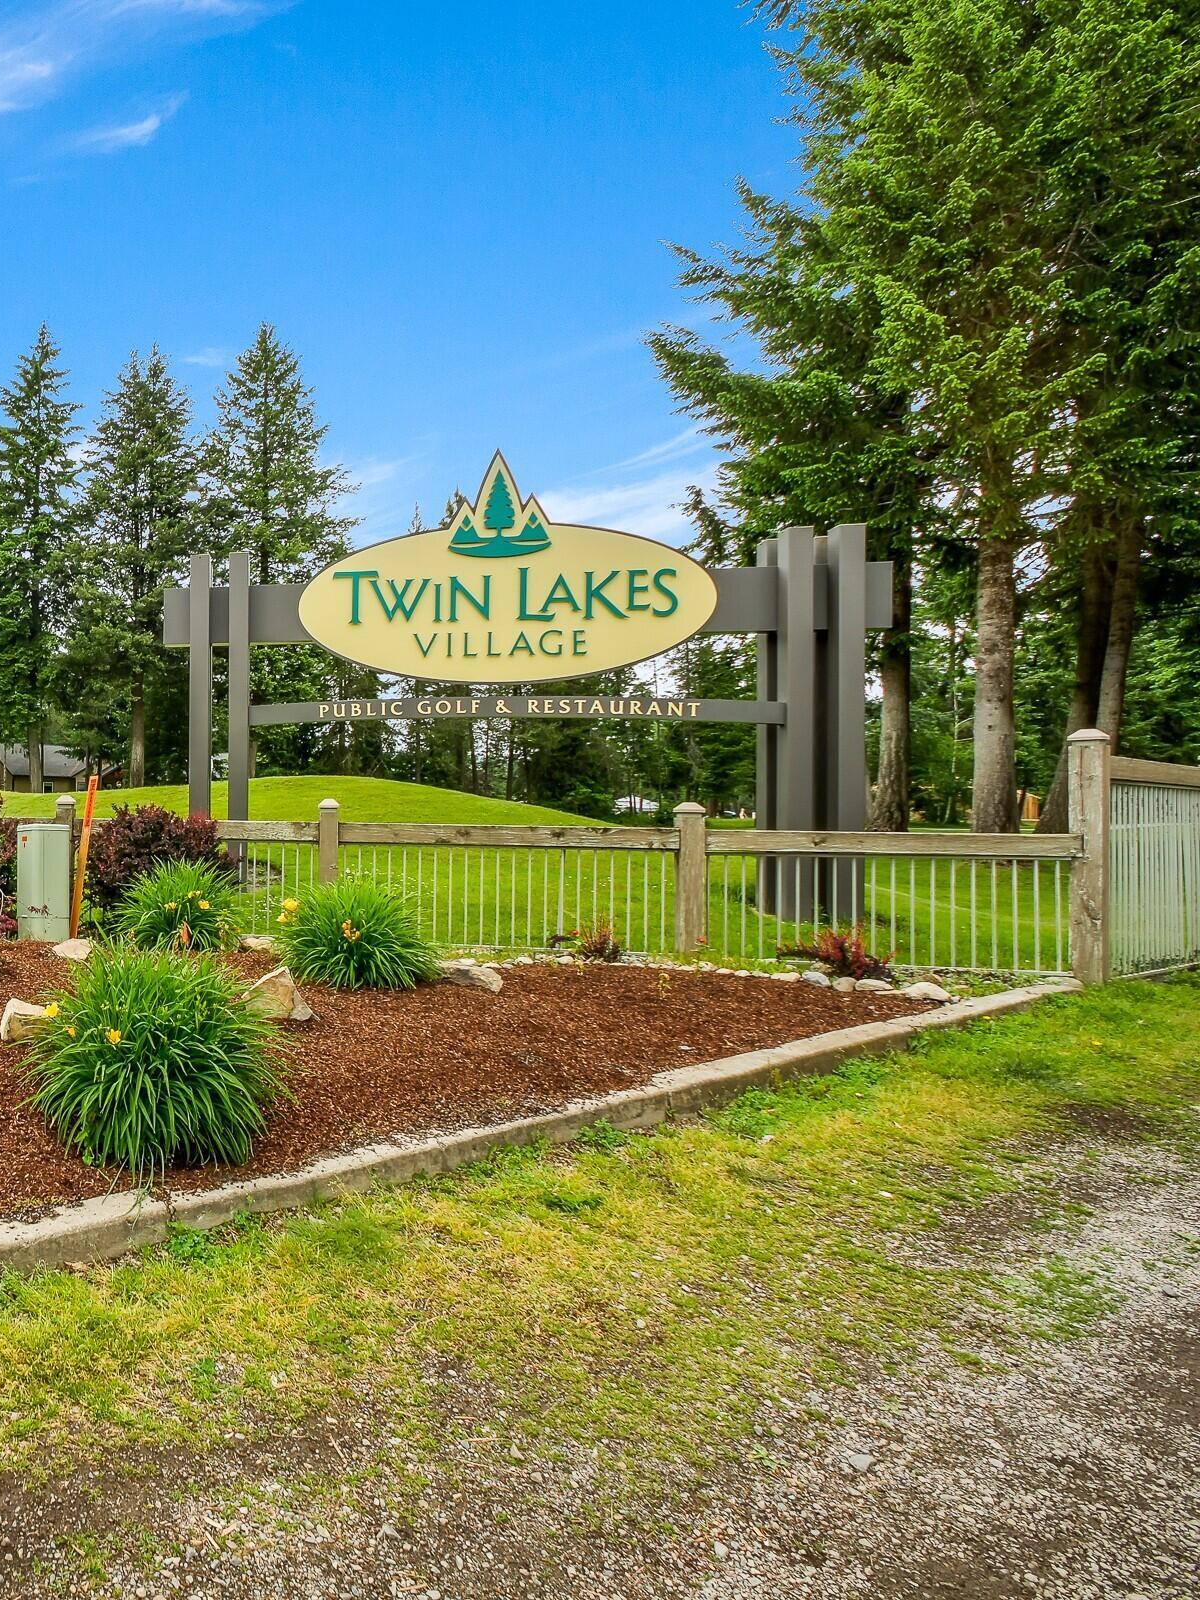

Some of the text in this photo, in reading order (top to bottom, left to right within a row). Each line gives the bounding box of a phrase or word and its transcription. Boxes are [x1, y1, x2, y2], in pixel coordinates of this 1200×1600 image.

[333, 566, 680, 625] TWIN LAKES
[412, 629, 588, 658] VILLAGE
[318, 699, 701, 718] PUBLIC GOLF & RESTAURANT
